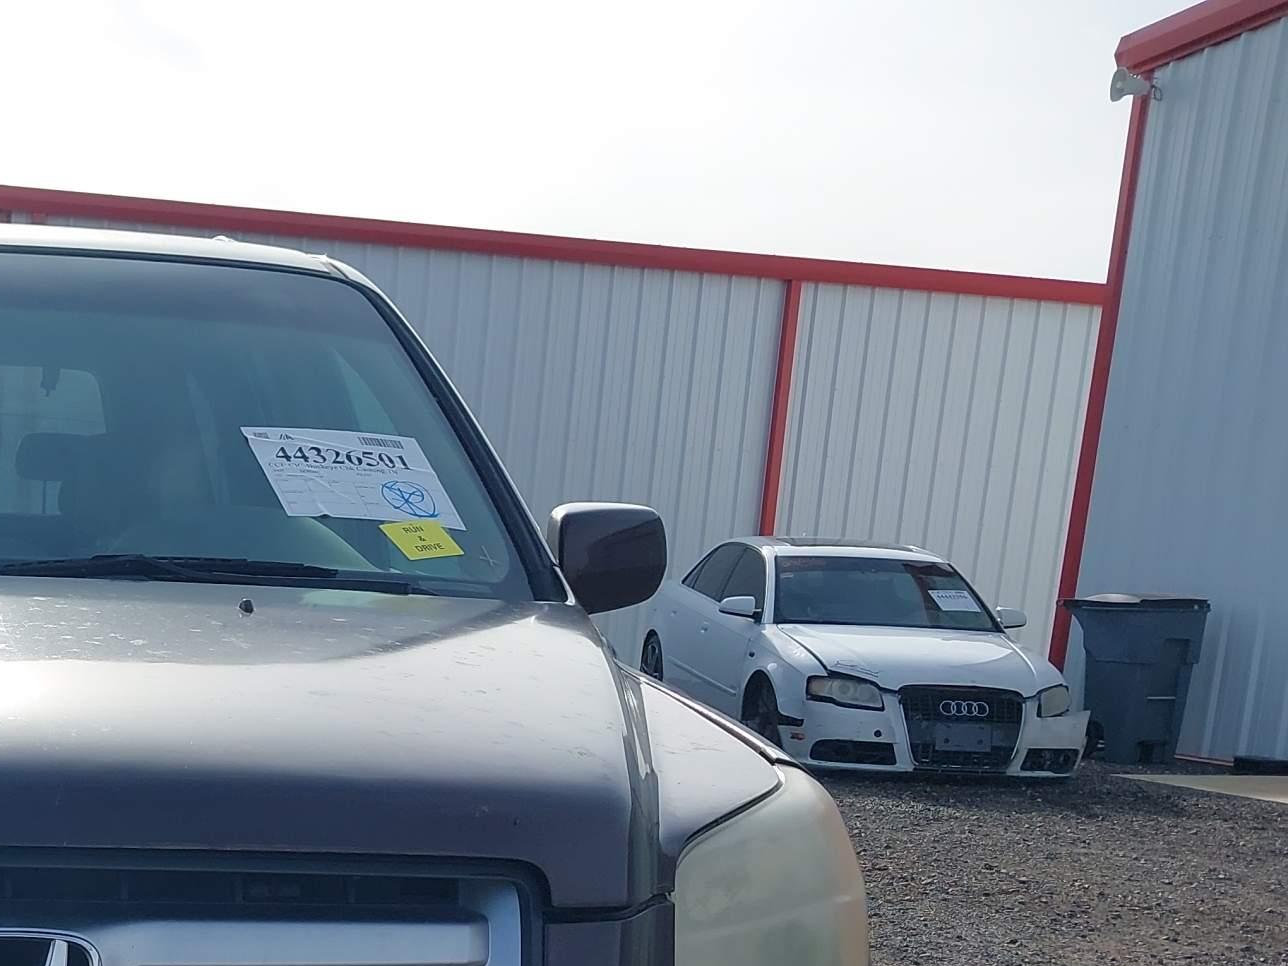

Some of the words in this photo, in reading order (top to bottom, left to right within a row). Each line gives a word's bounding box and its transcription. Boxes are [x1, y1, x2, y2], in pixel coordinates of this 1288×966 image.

[274, 446, 413, 471] 44326501
[402, 526, 424, 534] RUN
[415, 543, 445, 552] DRIVE
